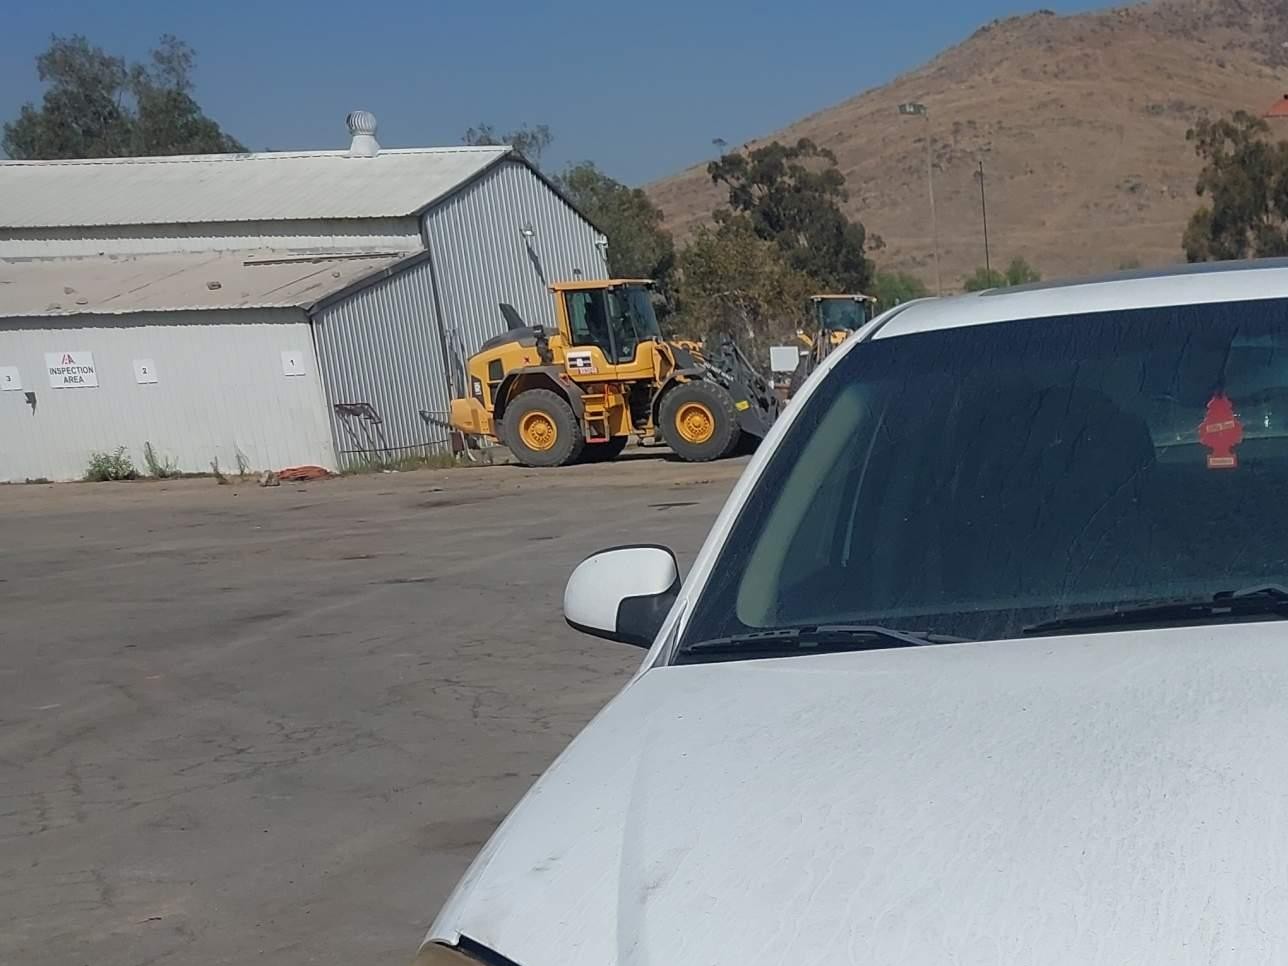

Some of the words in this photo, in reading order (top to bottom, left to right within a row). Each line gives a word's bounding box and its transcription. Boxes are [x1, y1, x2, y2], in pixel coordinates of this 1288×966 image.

[50, 366, 94, 376] INSPECTION
[142, 367, 148, 375] 2
[63, 375, 85, 384] AREA
